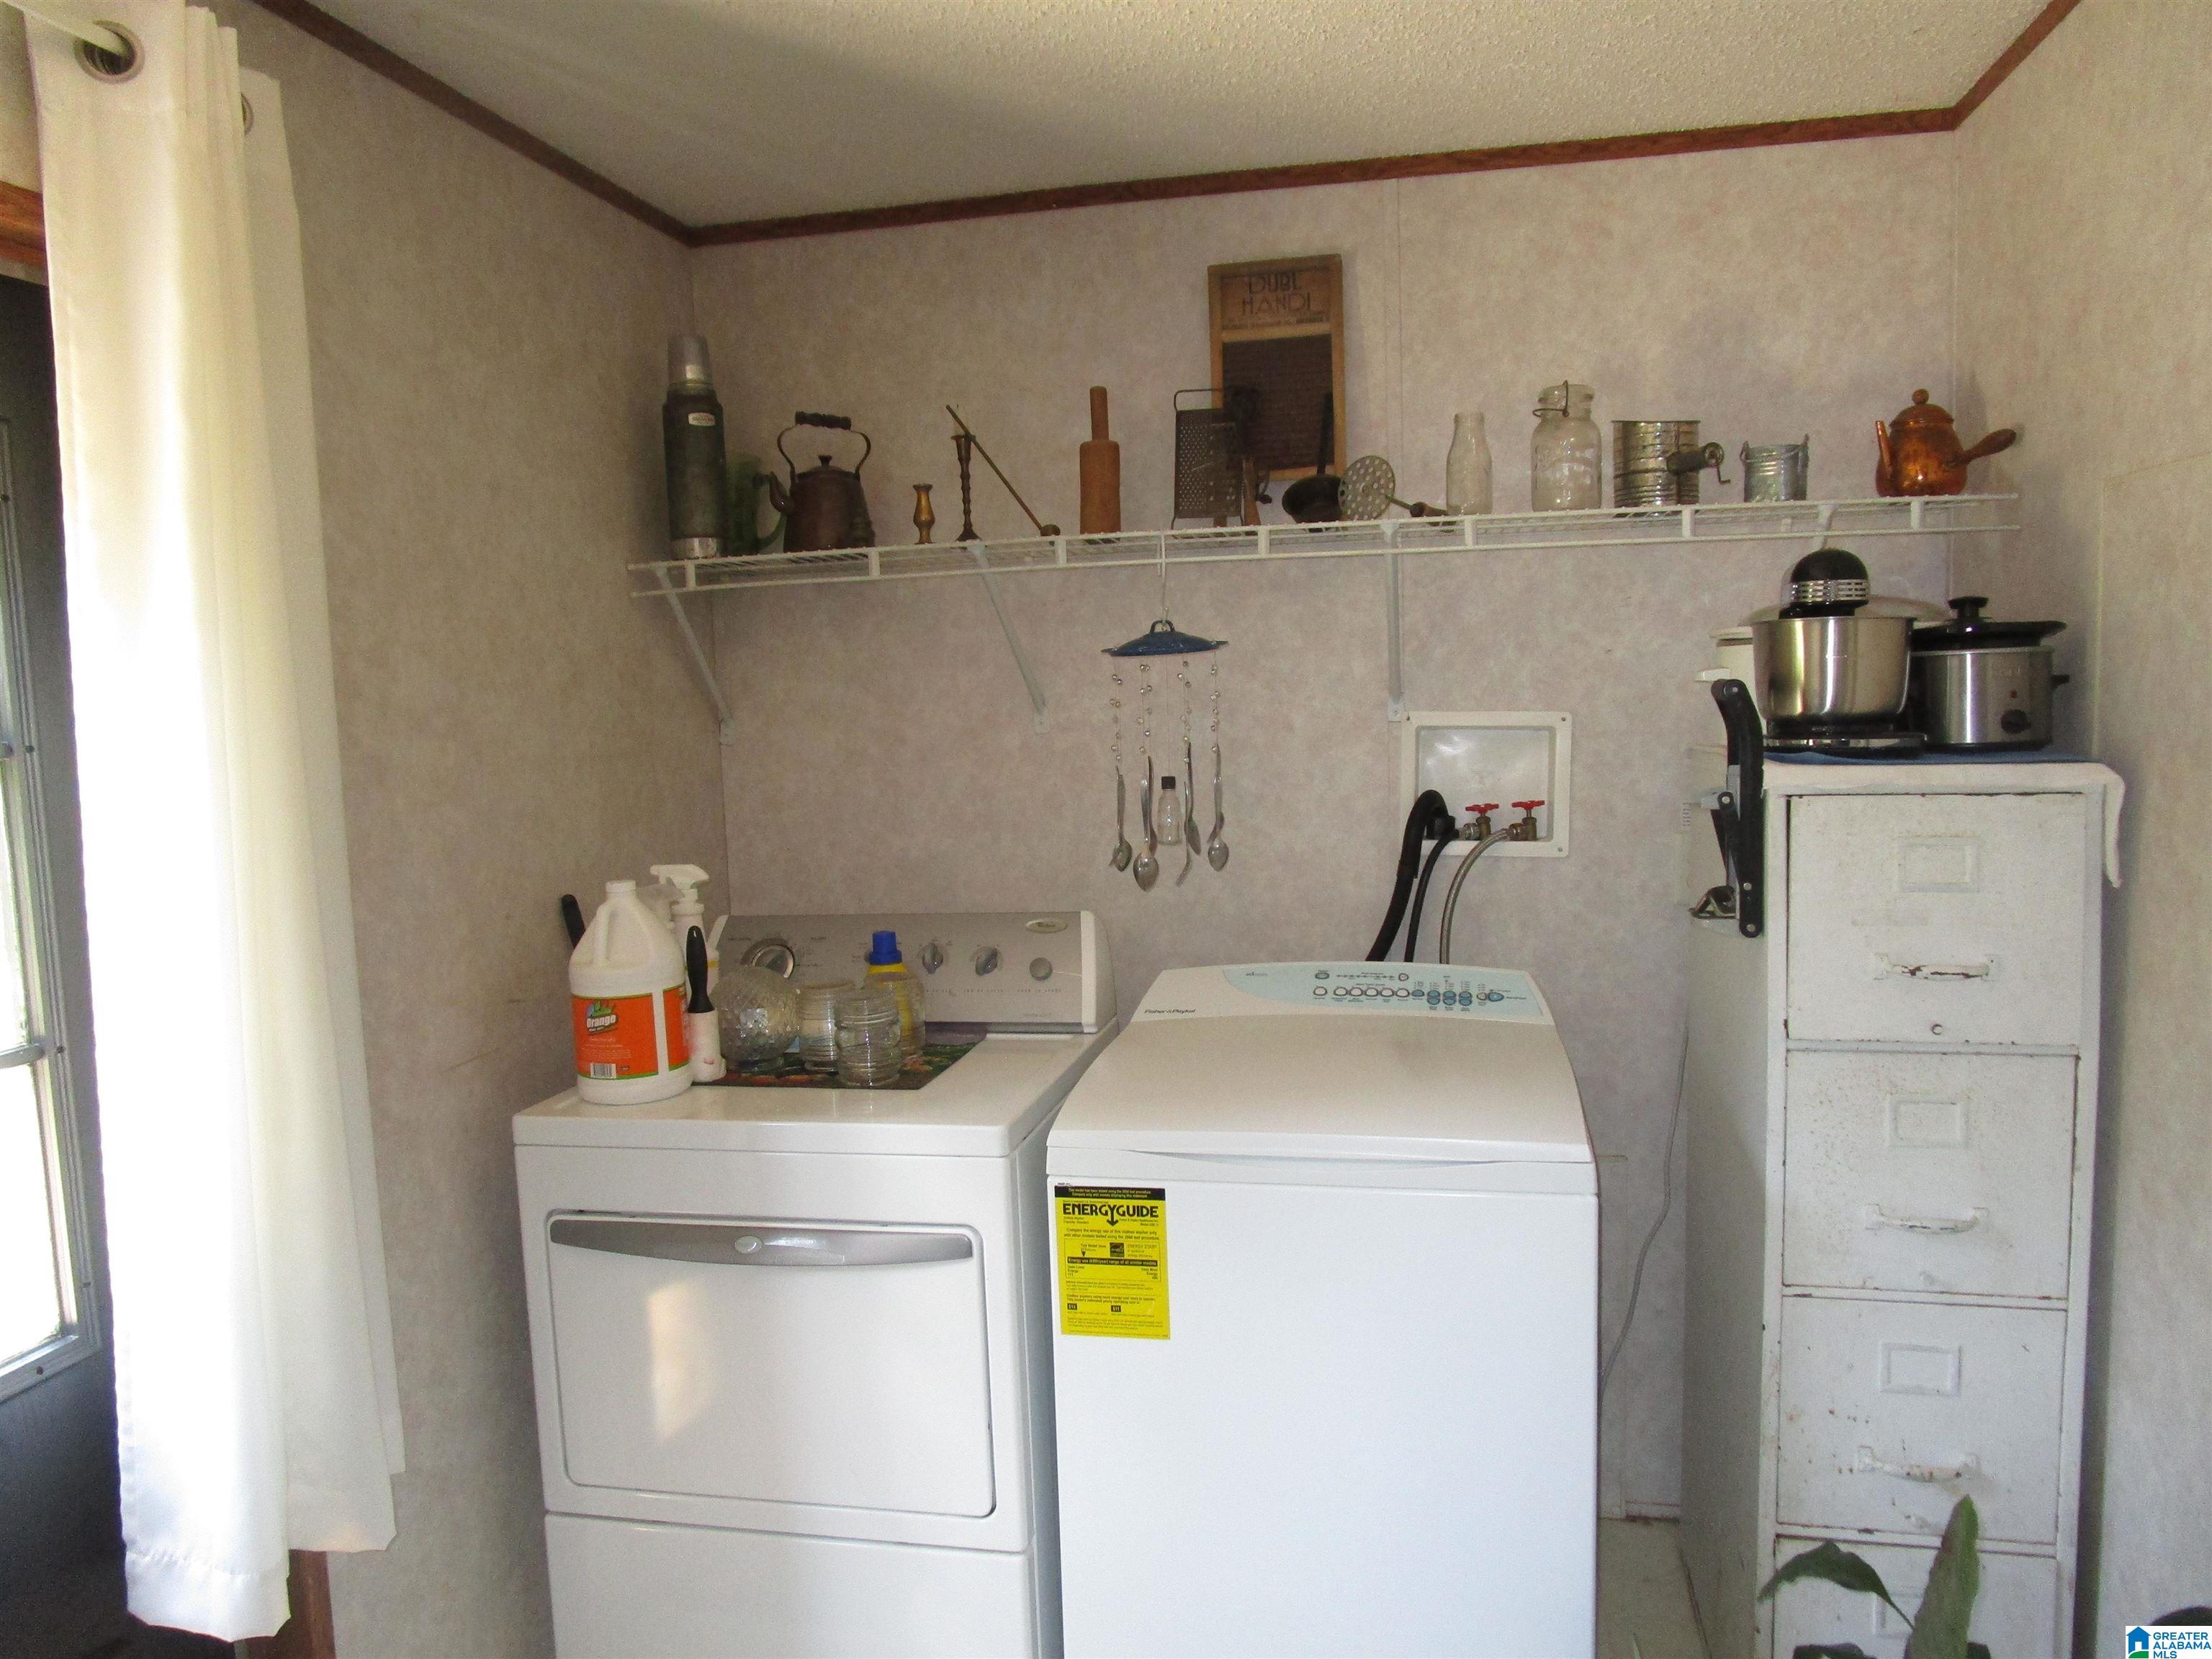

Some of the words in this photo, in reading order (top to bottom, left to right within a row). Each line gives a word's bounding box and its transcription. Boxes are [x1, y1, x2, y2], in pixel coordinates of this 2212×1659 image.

[1248, 270, 1300, 295] DUBL
[586, 1015, 616, 1028] Orange
[1062, 1202, 1159, 1218] ENERGYGUIDE
